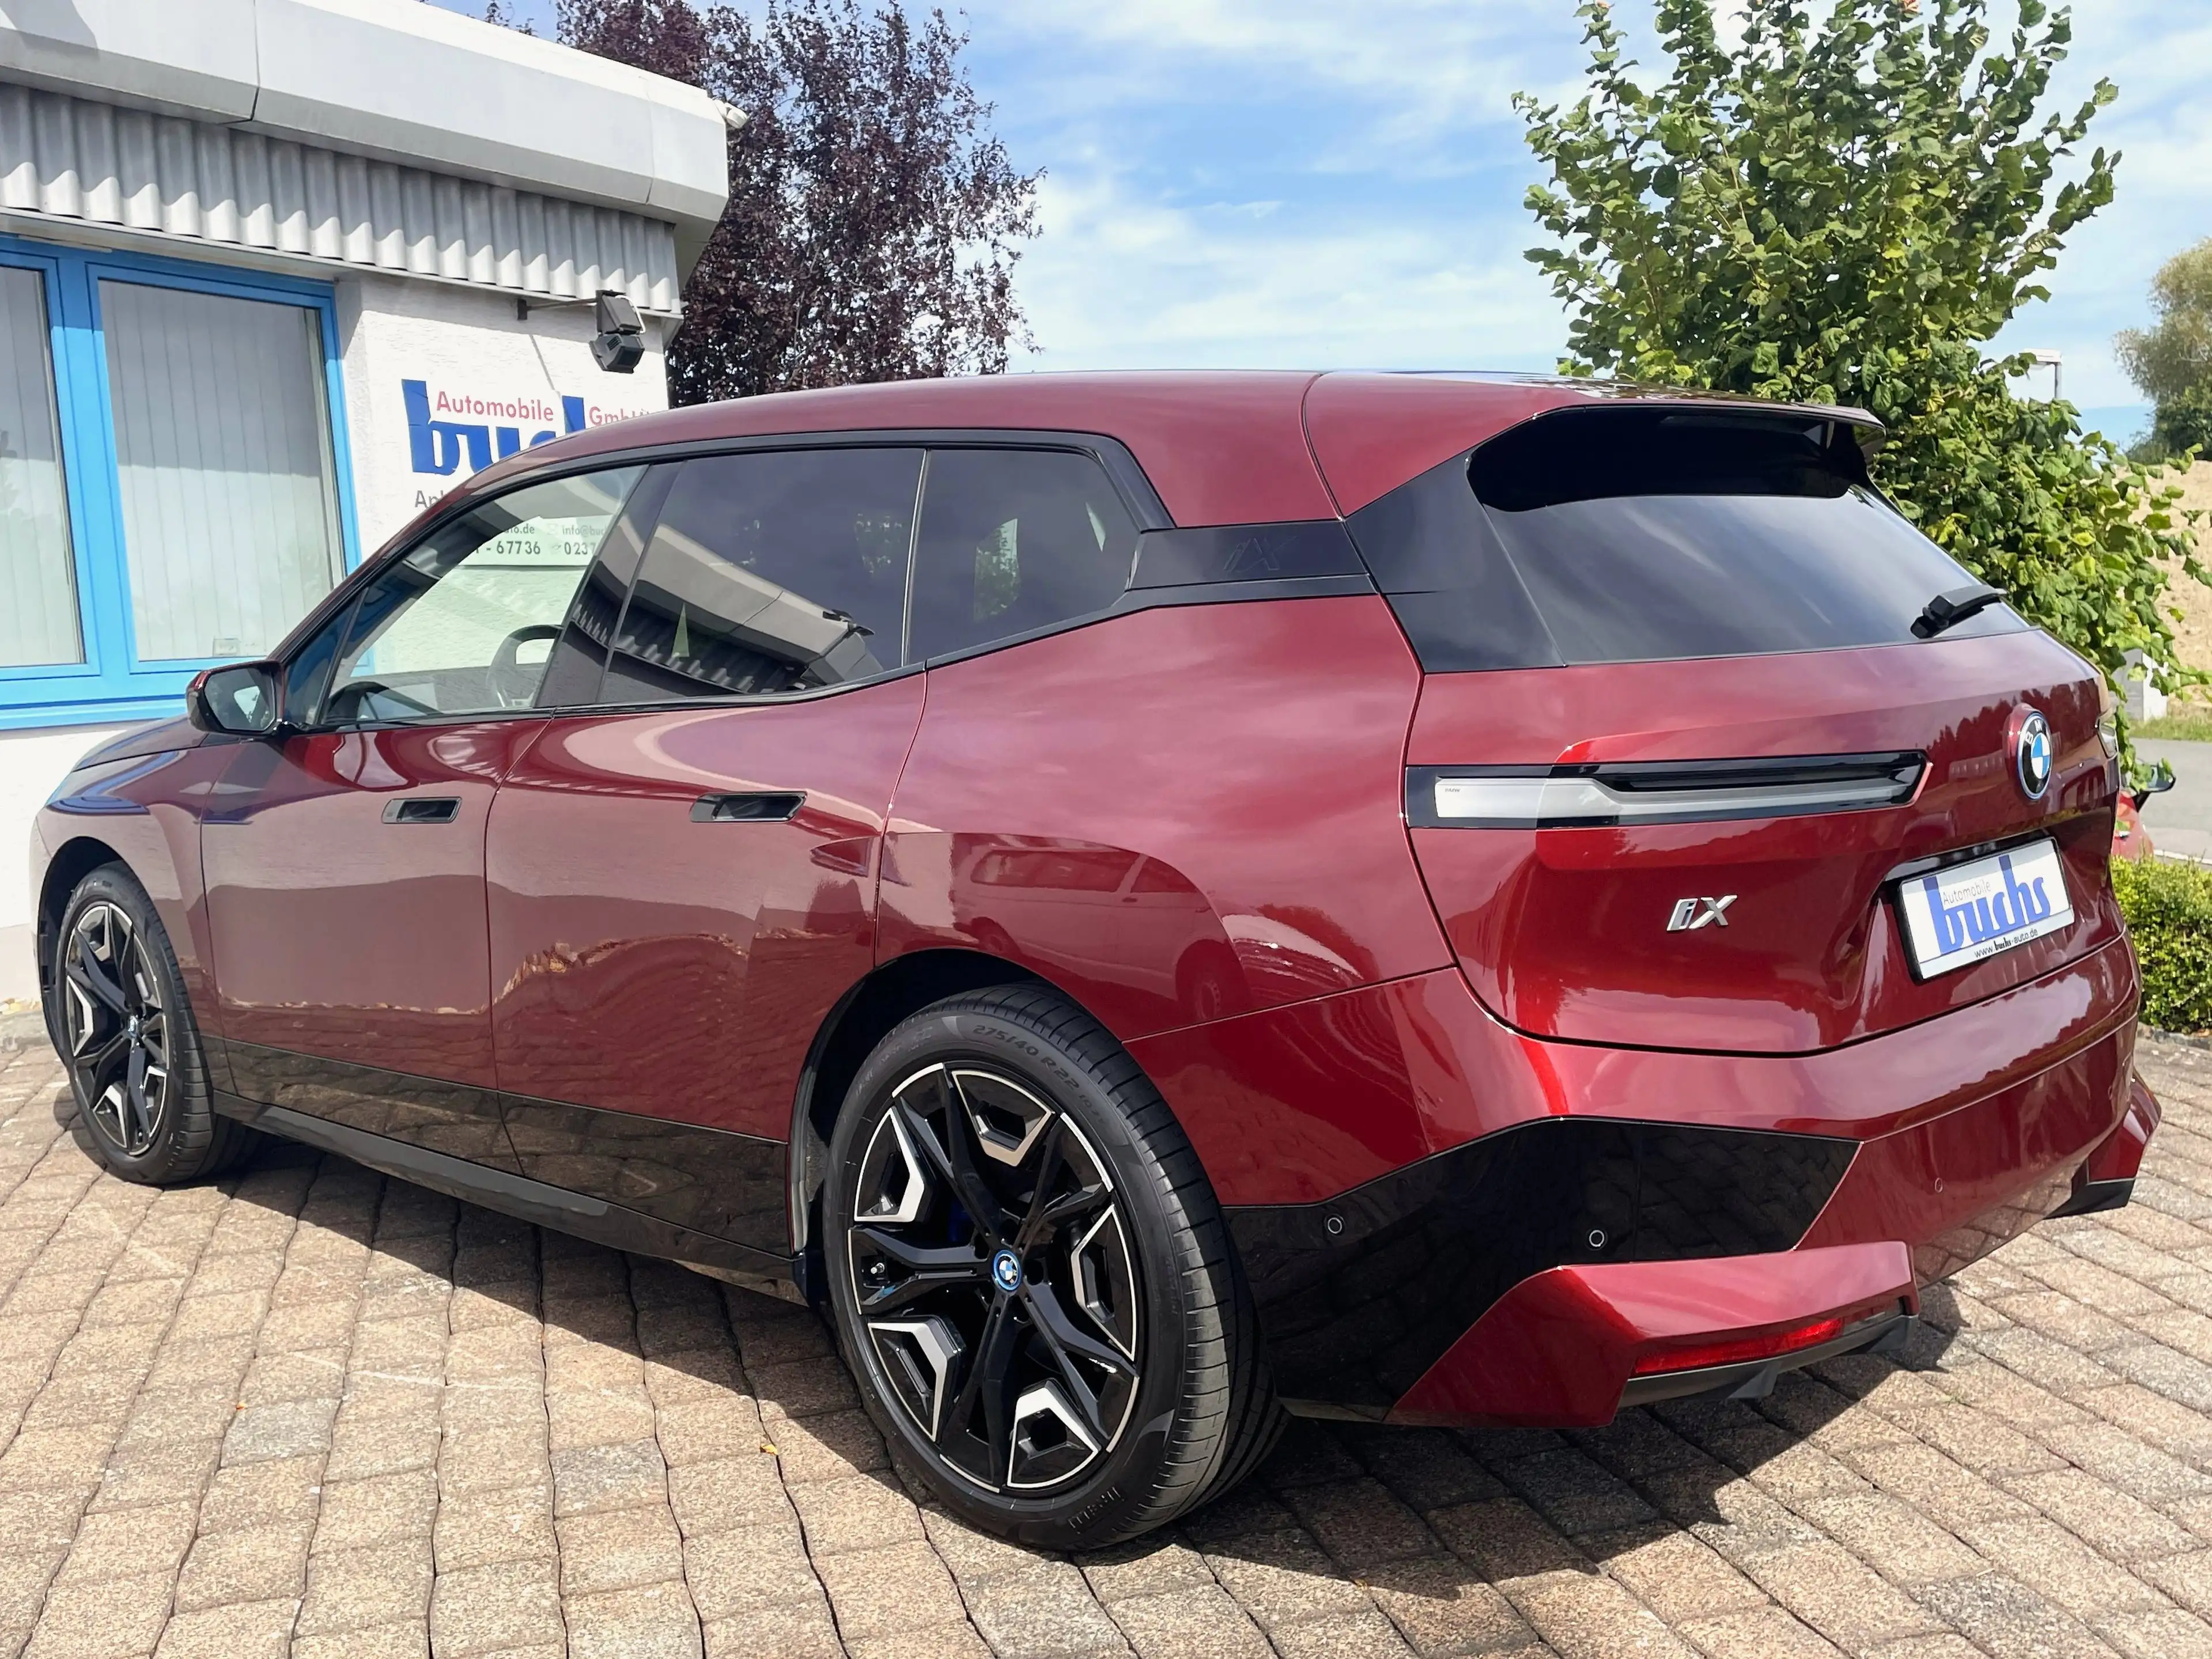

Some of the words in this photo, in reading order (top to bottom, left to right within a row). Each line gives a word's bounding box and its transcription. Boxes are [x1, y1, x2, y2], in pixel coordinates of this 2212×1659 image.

[437, 391, 554, 421] Automobile
[589, 407, 643, 426] Gmb
[497, 540, 540, 555] 67736
[1922, 854, 2051, 956] buchs
[1942, 880, 1991, 904] Automobile
[1666, 895, 1738, 931] iX
[1974, 929, 2039, 958] www.buchs-auto.de
[972, 1024, 1039, 1056] 275/40
[1040, 1056, 1080, 1090] R22
